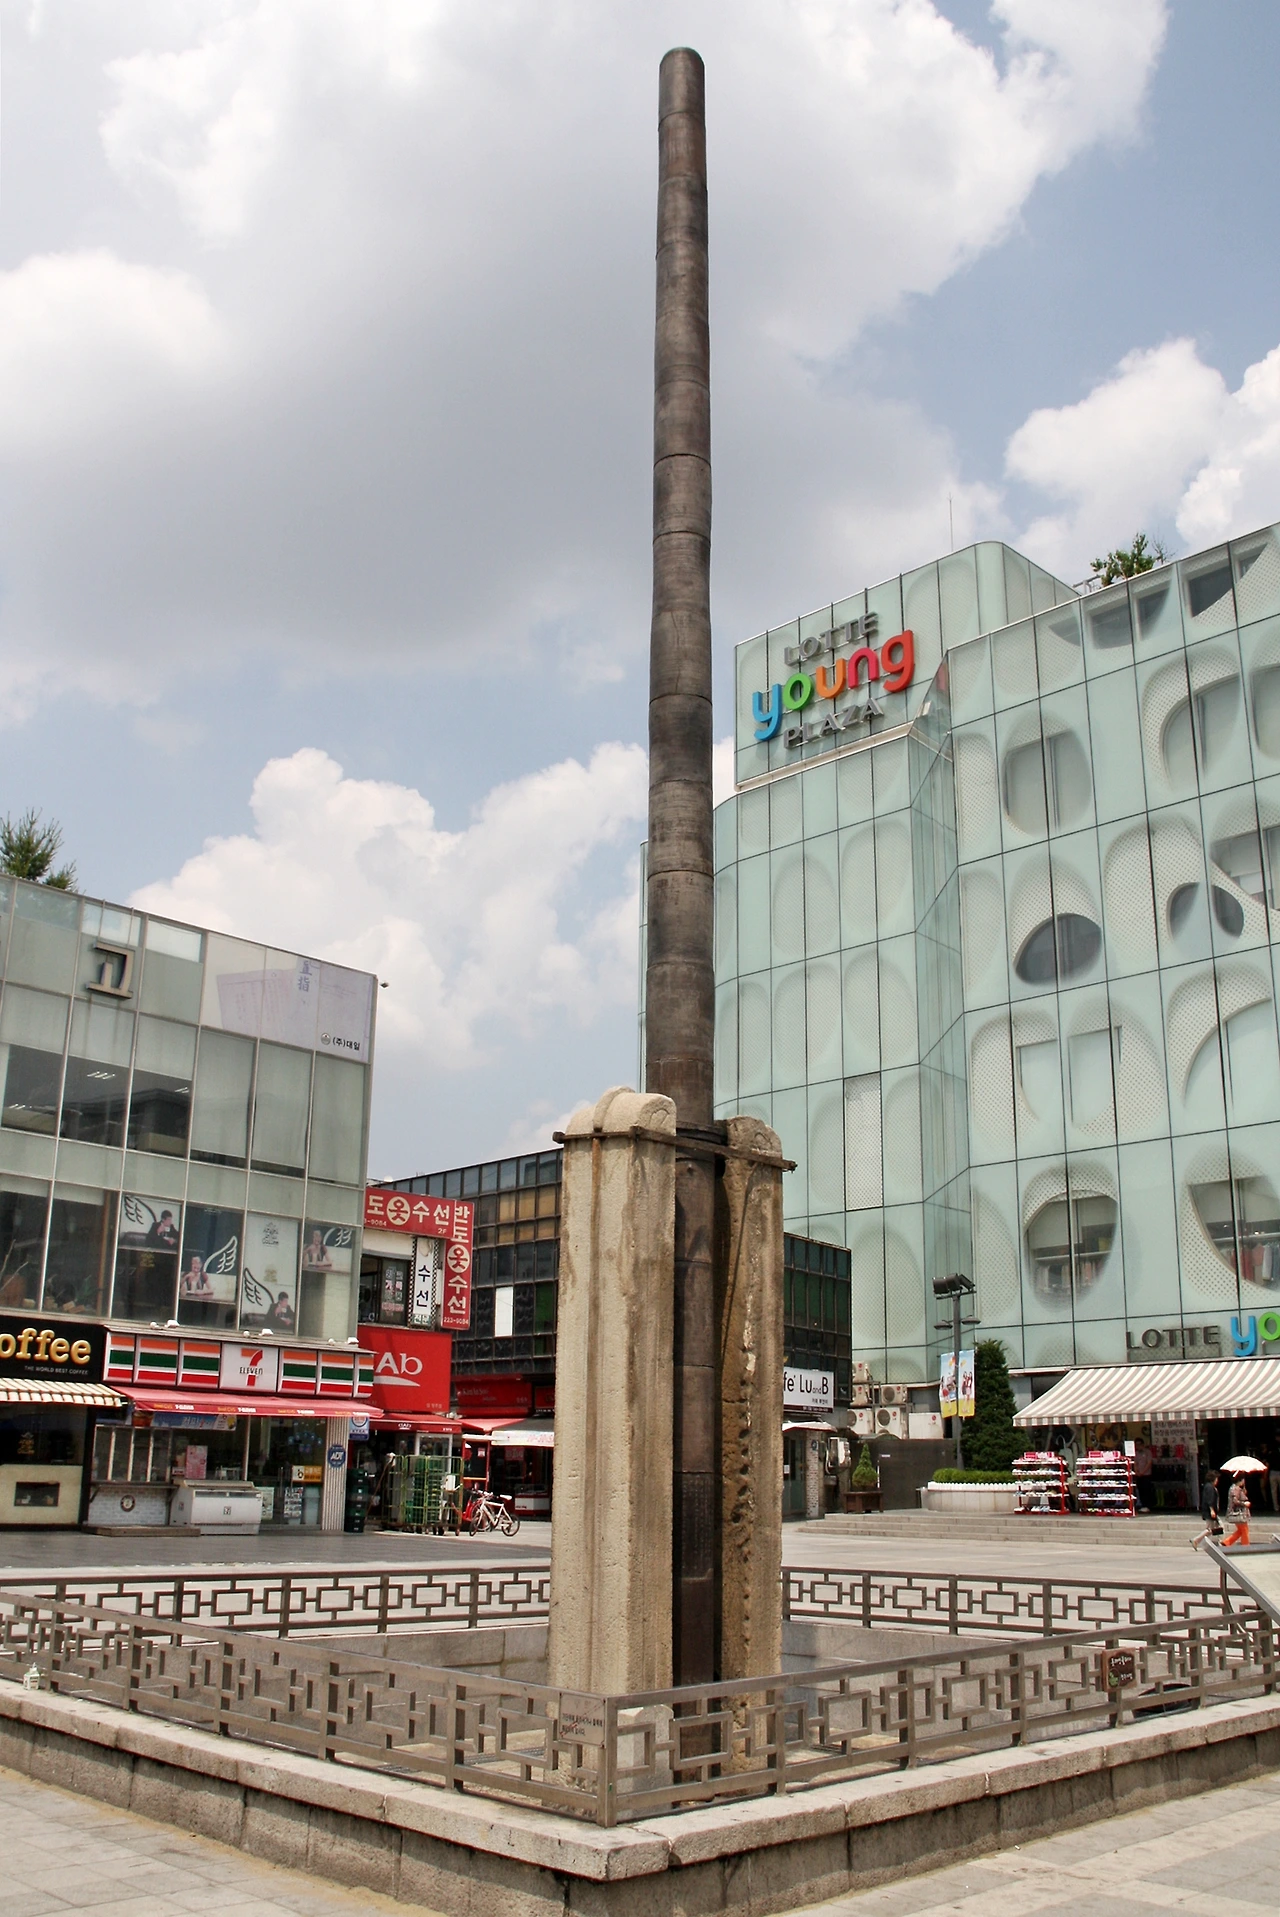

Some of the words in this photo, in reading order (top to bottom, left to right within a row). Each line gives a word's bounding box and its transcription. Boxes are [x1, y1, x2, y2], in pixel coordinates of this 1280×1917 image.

[784, 611, 879, 667] LOTTE
[752, 629, 916, 741] young
[784, 697, 884, 749] PLAZA
[85, 940, 136, 999] 고
[332, 1037, 361, 1051] (주)대일
[1126, 1325, 1220, 1349] LOTTE
[241, 1347, 263, 1387] 7
[330, 1451, 344, 1461] ADT
